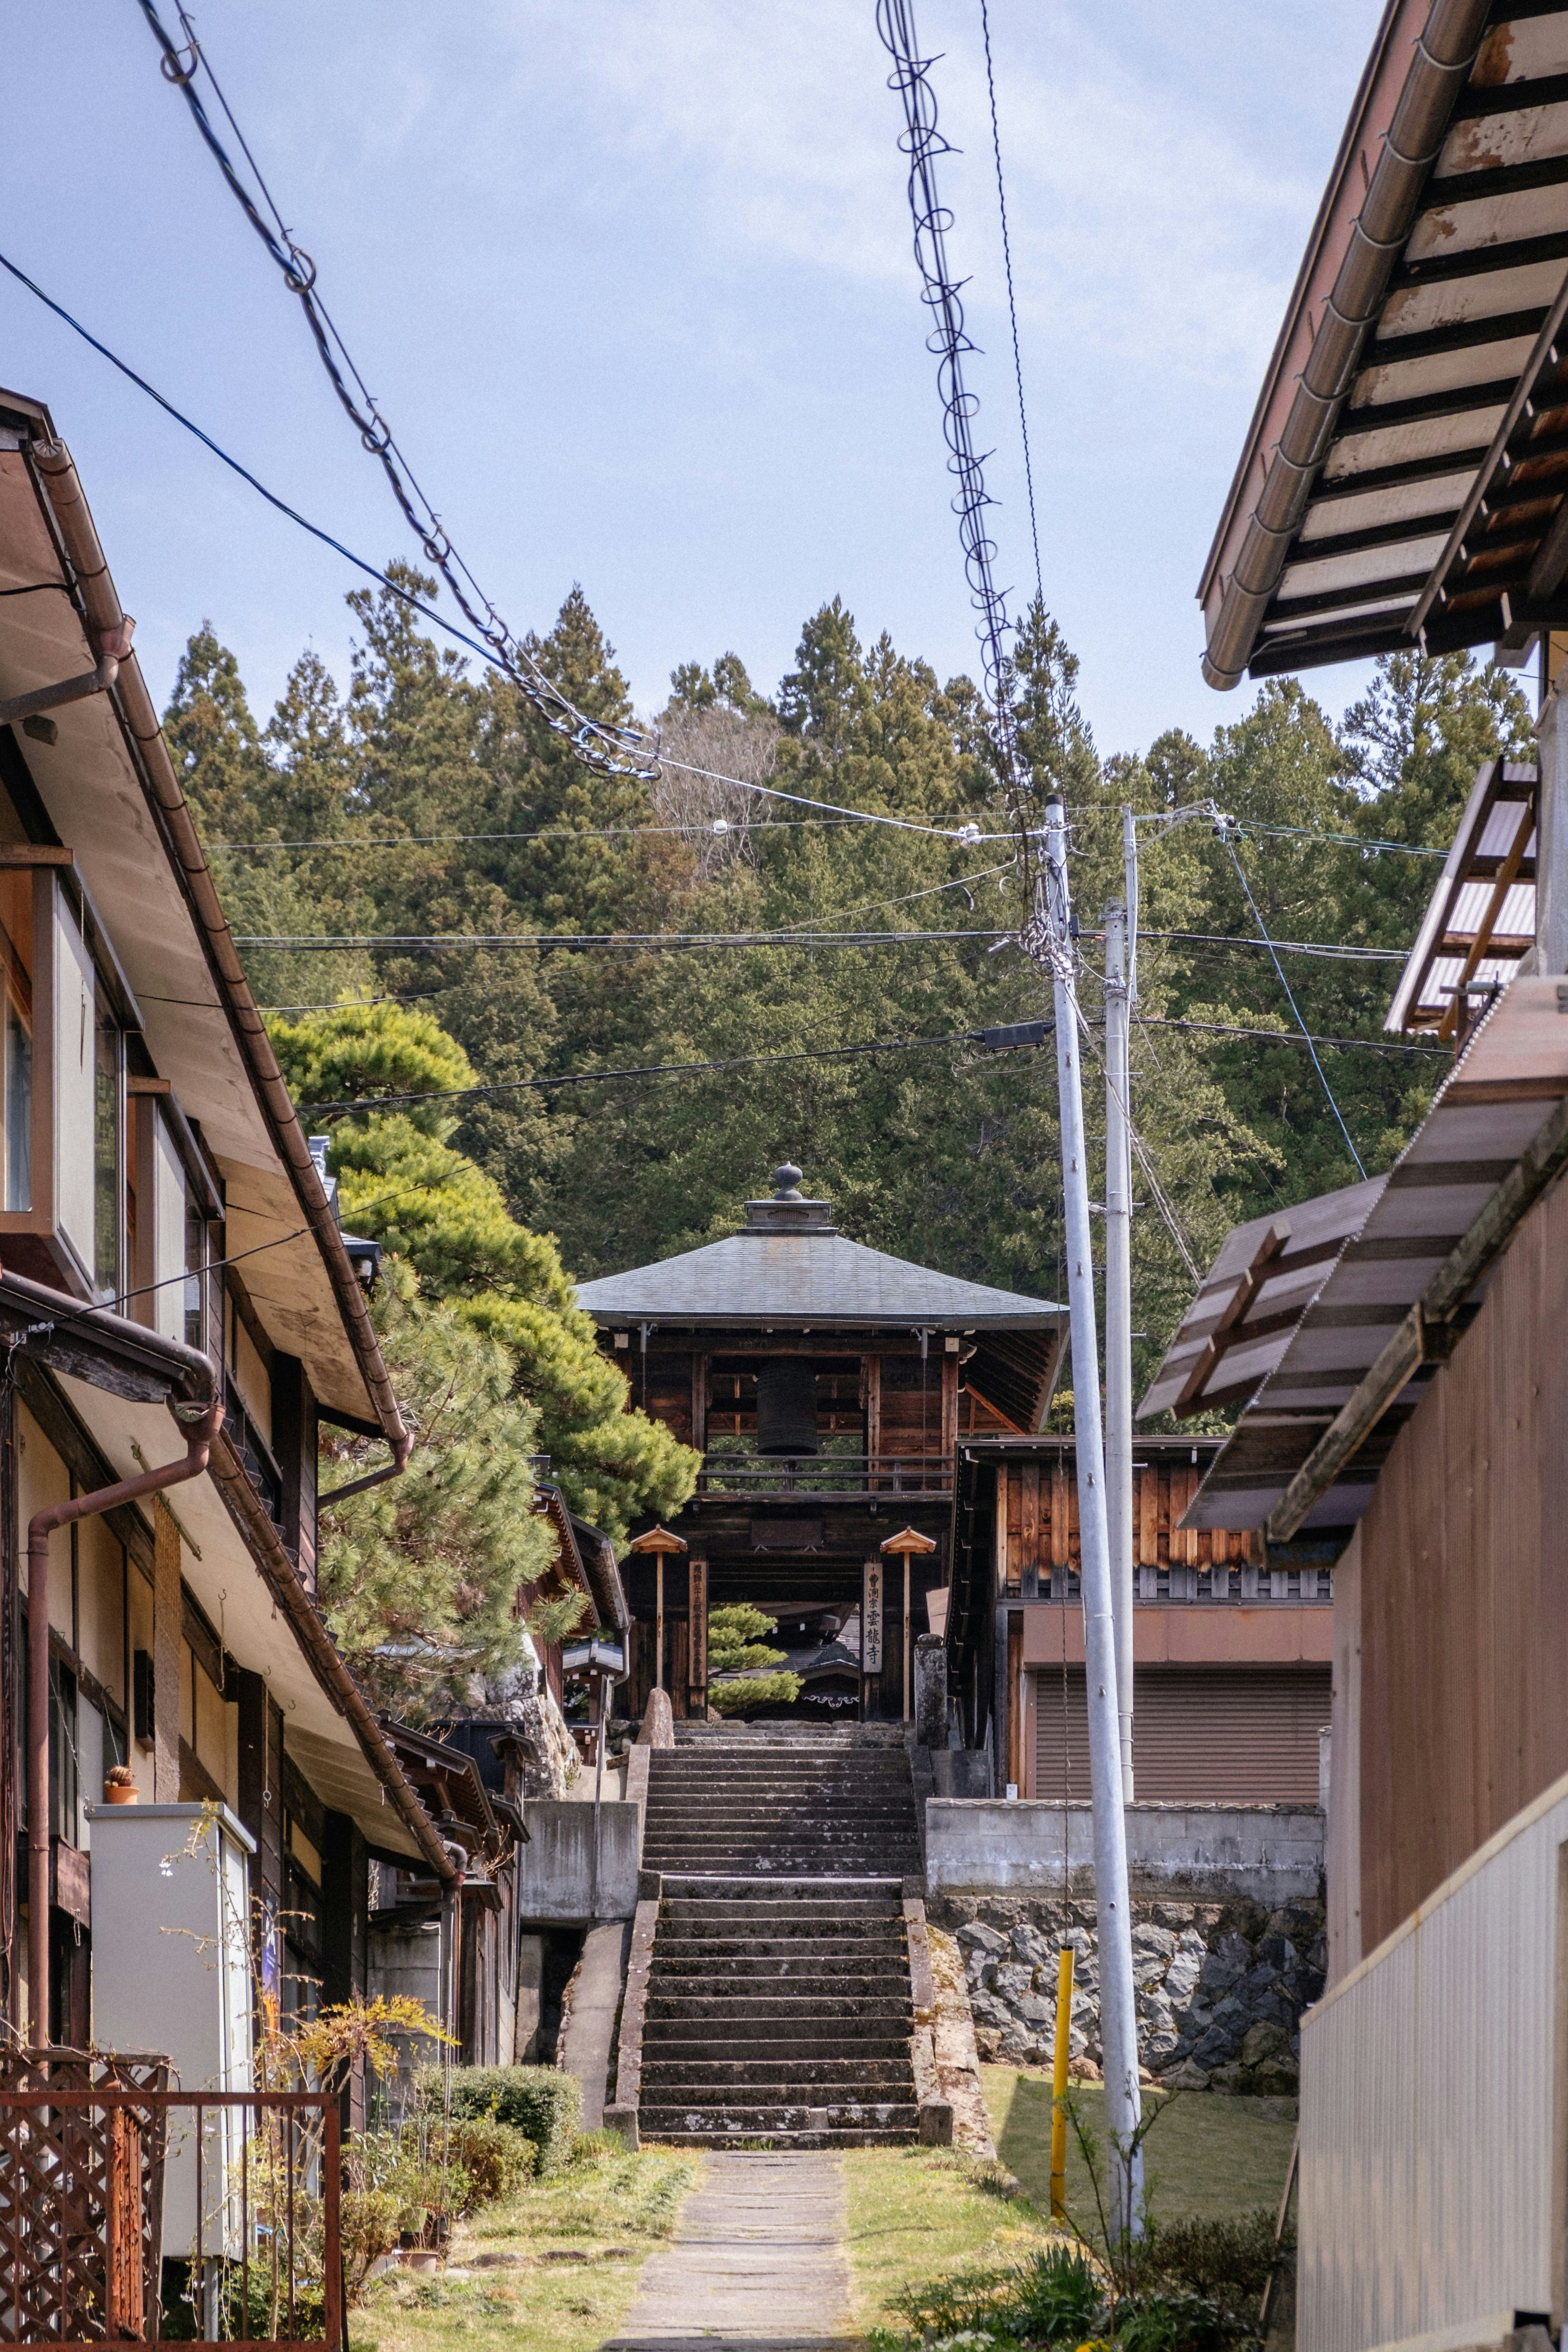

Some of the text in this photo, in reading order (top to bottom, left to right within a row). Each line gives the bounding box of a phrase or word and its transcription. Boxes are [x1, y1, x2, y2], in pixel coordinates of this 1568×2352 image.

[865, 1574, 880, 1664] 曹洞宗雲龍寺
